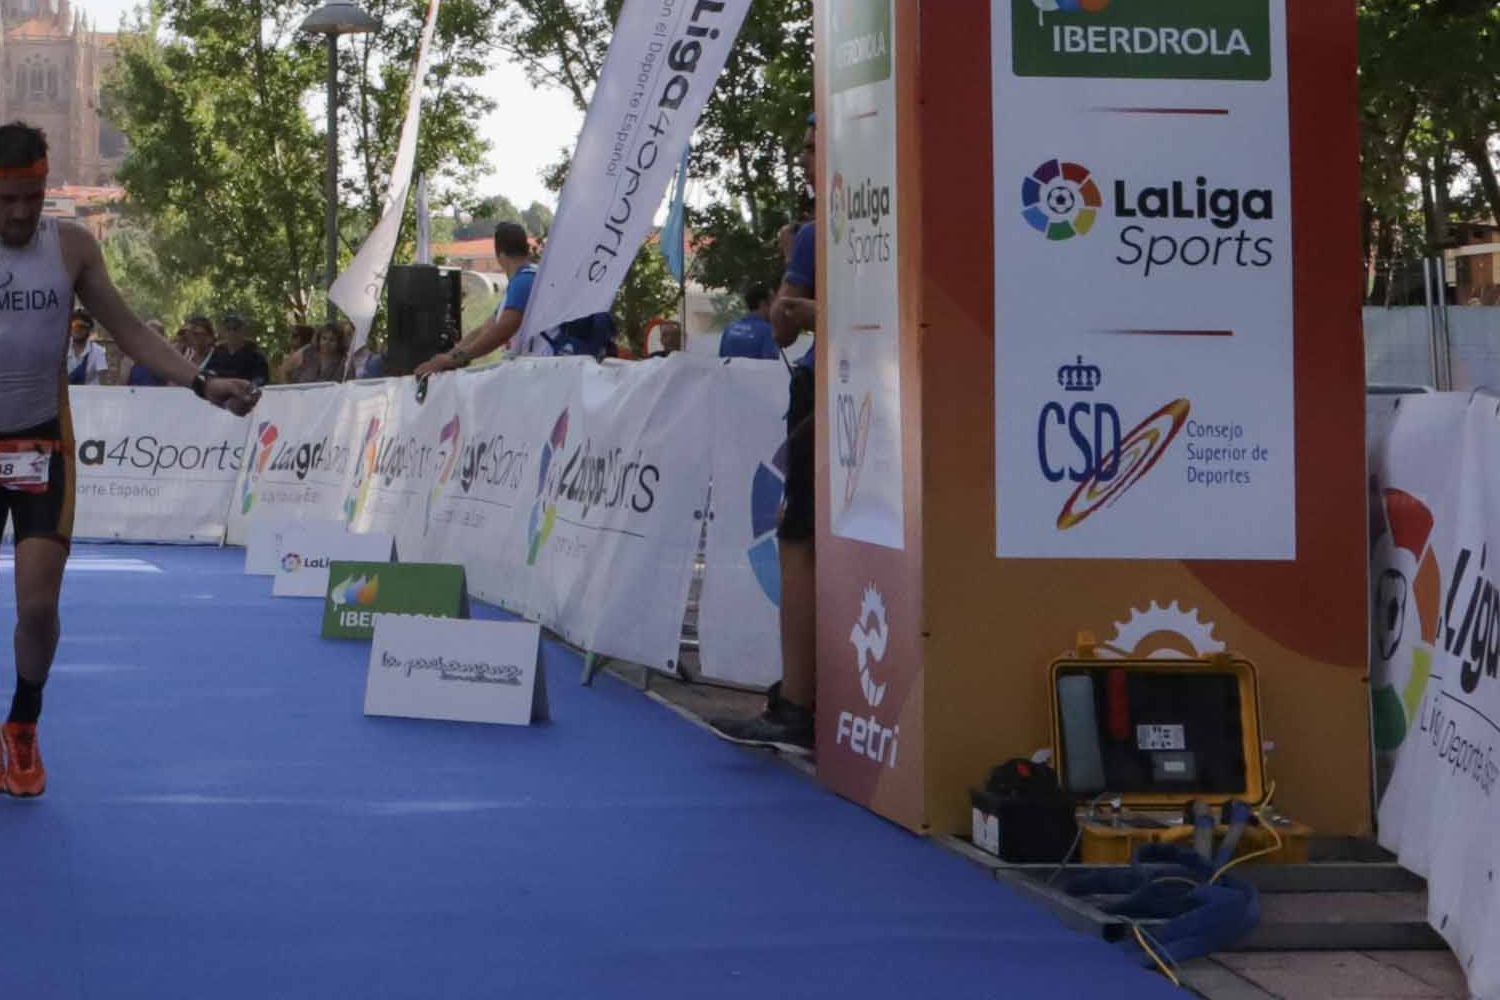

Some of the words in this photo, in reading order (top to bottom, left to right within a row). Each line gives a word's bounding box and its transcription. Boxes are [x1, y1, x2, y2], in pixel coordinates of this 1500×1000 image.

[1052, 26, 1252, 56] IBERDROLA
[847, 178, 890, 226] LaLiga
[1114, 176, 1274, 230] LaLiga
[1115, 225, 1273, 277] Sports
[1037, 401, 1122, 482] CSD
[1186, 419, 1243, 440] Consejo
[1186, 443, 1246, 465] Superior
[1251, 444, 1268, 460] de
[1186, 466, 1251, 486] Deportes
